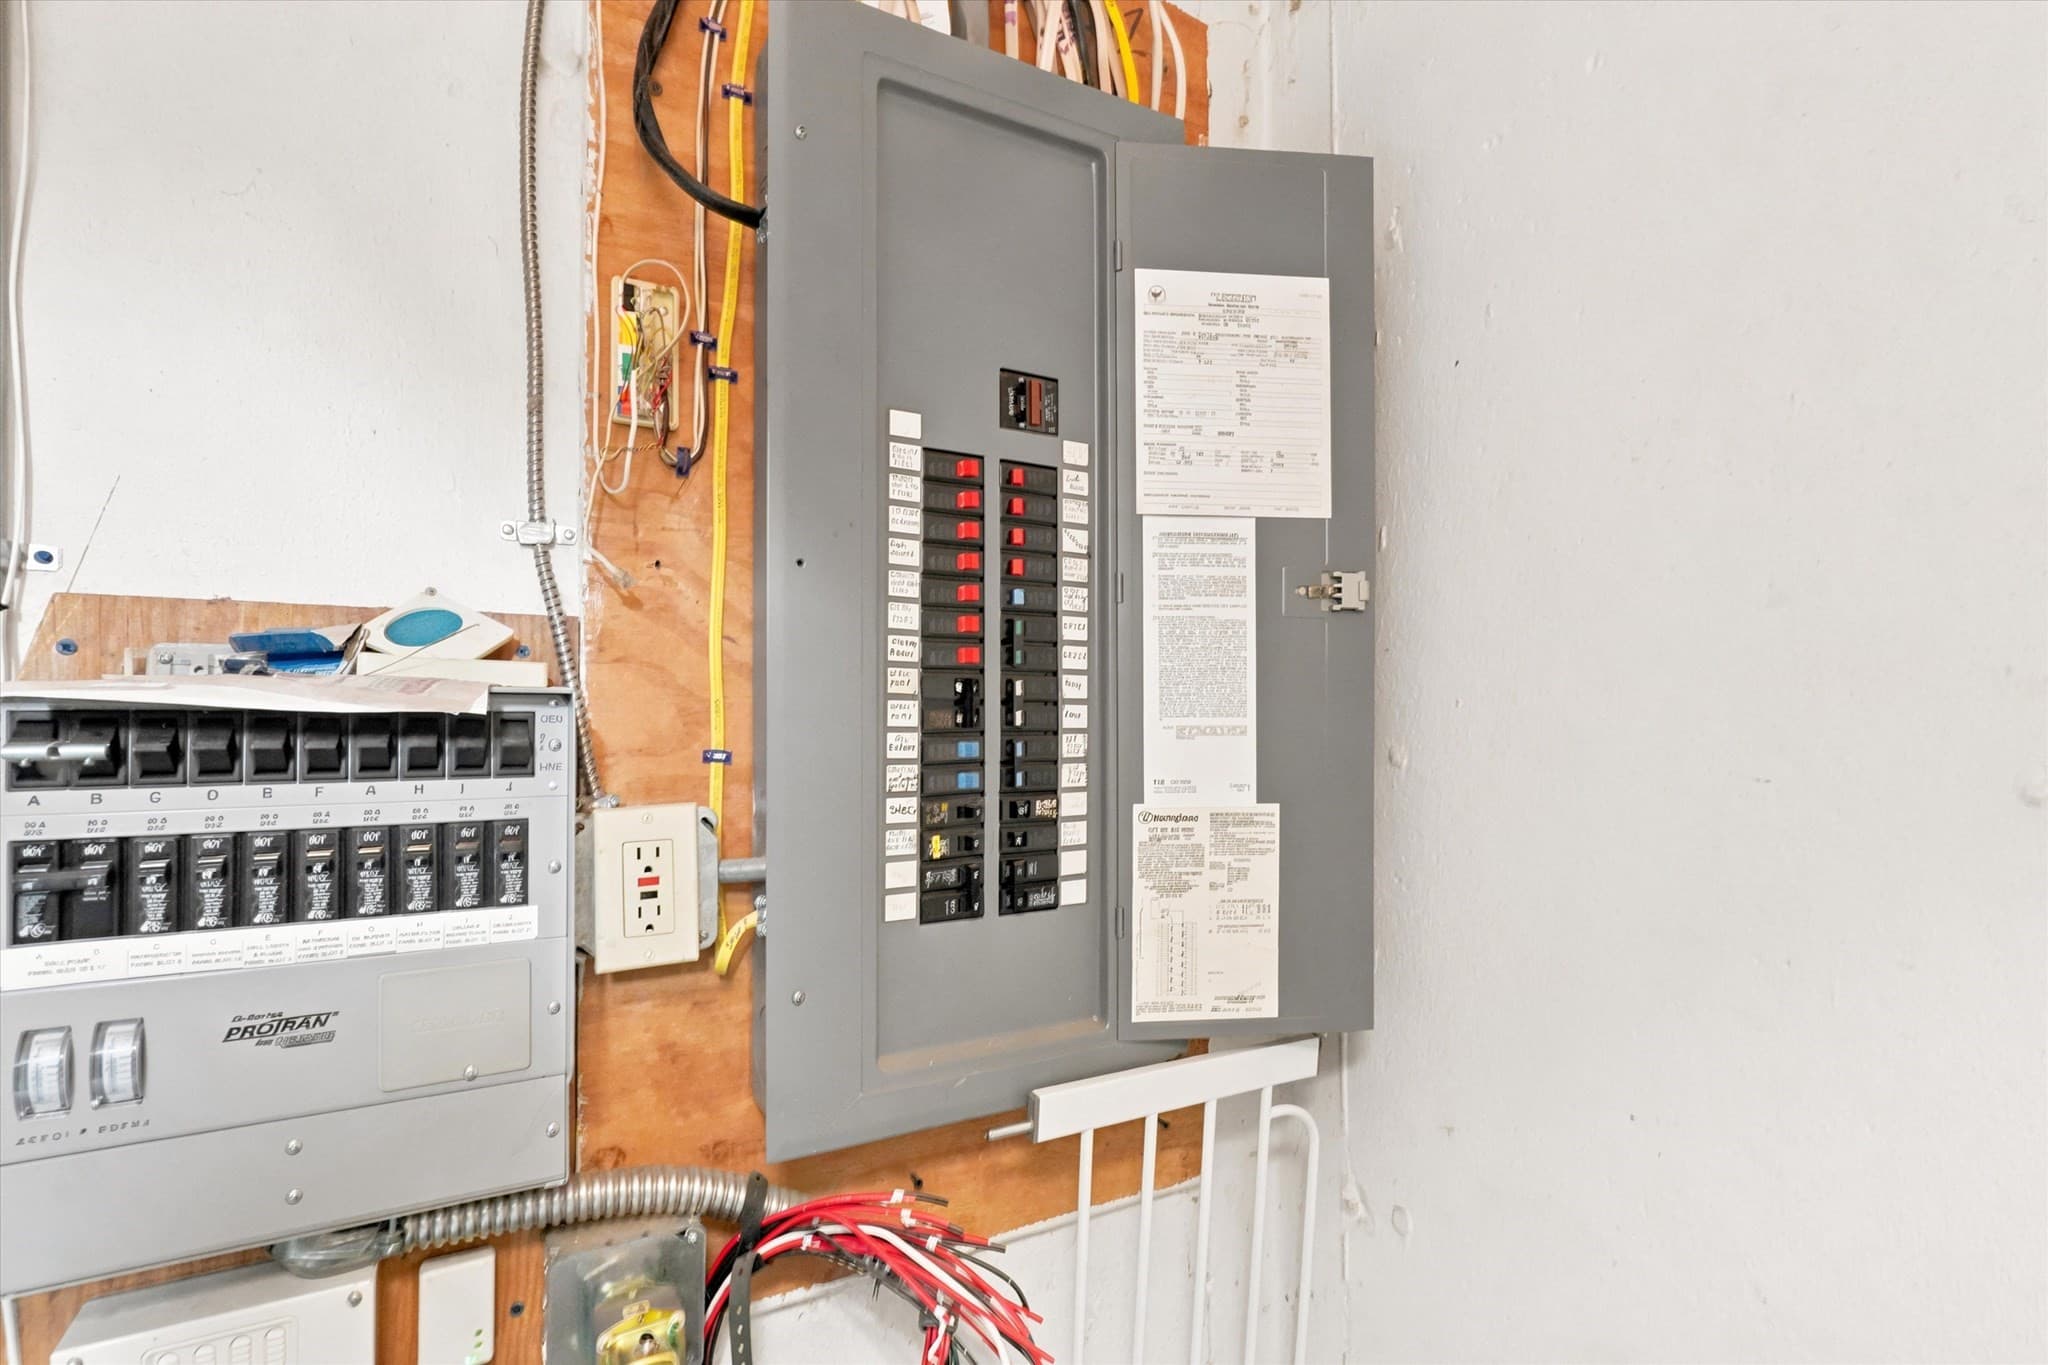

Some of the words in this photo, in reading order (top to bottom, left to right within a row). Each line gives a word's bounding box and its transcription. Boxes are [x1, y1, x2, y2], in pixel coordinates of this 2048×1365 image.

[27, 795, 41, 806] A
[90, 793, 103, 805] B
[414, 784, 424, 795] H
[222, 1012, 332, 1042] PROTRAN
